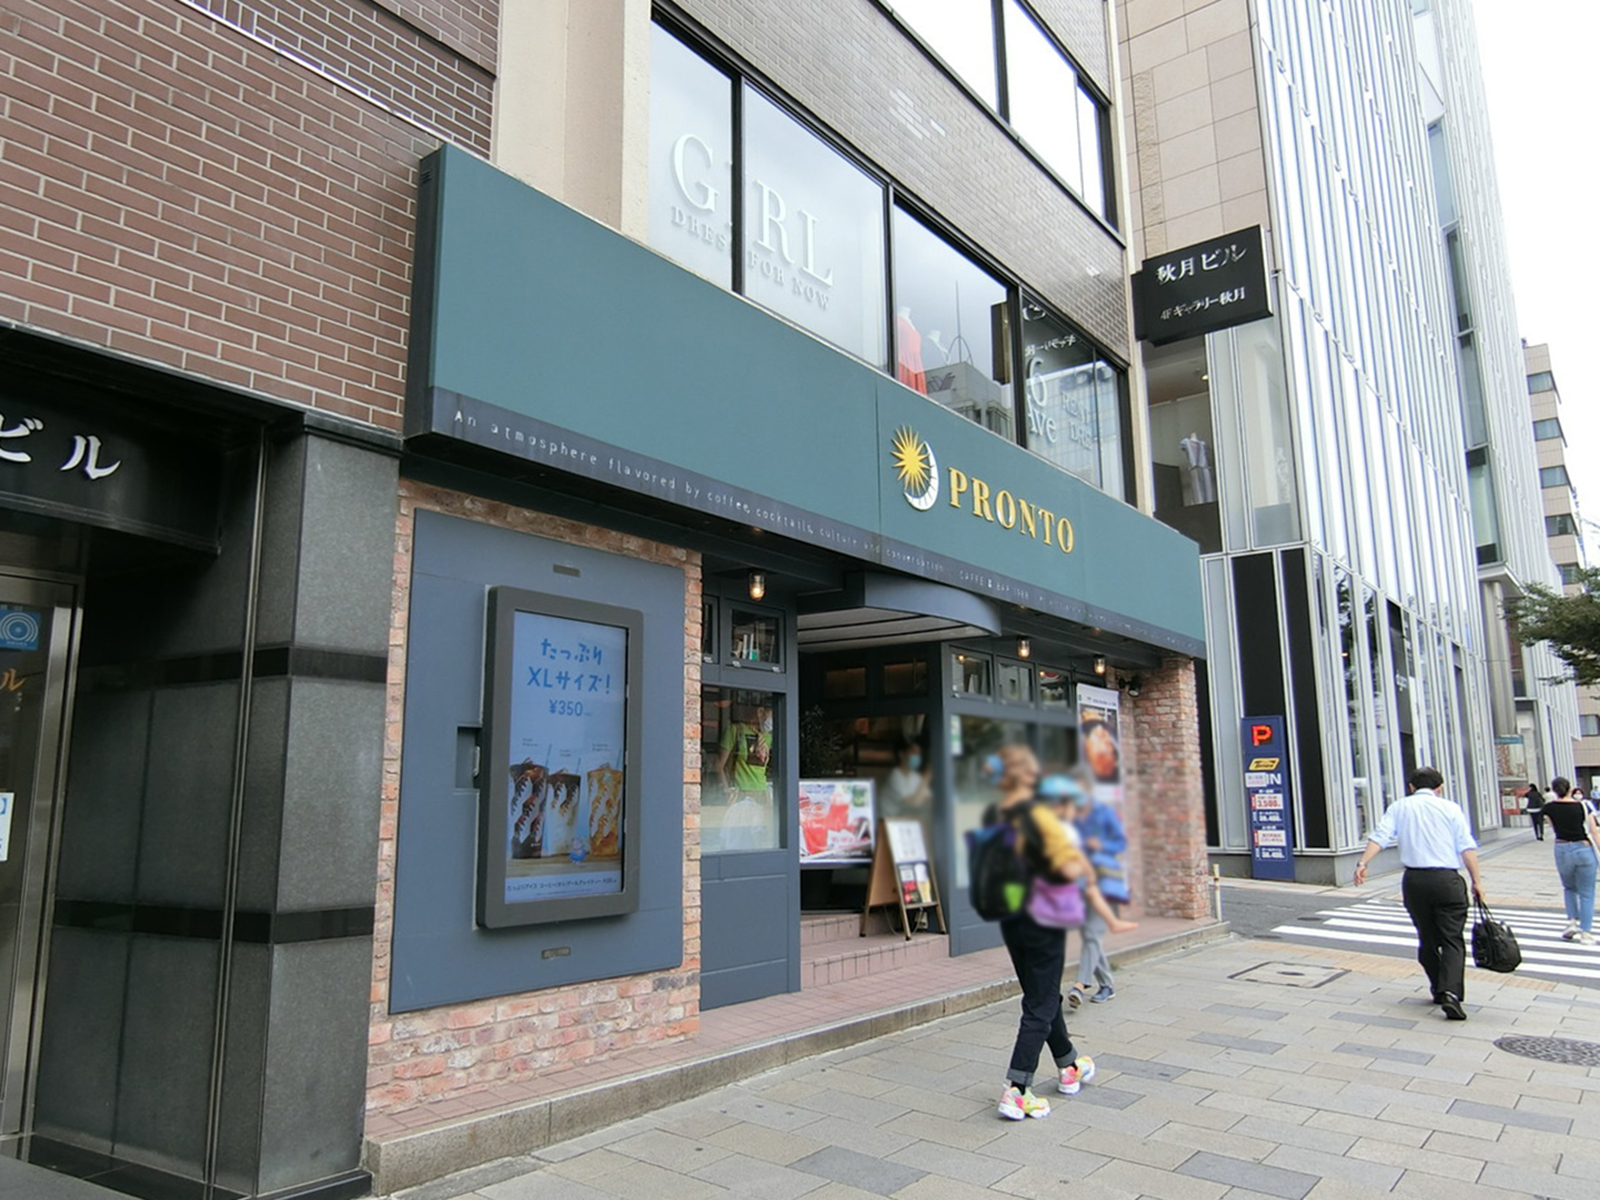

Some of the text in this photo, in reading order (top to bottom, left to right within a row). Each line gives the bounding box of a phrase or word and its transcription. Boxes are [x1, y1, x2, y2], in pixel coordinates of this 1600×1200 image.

[672, 133, 833, 287] GRL
[671, 206, 831, 310] DRES FOR NOW
[1155, 243, 1247, 285] 秋月ビル
[0, 413, 121, 479] ビル
[454, 410, 477, 427] An
[491, 423, 598, 465] atmosphere
[608, 457, 676, 489] flavored
[685, 481, 700, 498] by
[947, 466, 1075, 553] PRONTO
[540, 637, 603, 665] たっぷり
[549, 699, 584, 717] ¥350
[1251, 724, 1273, 747] P
